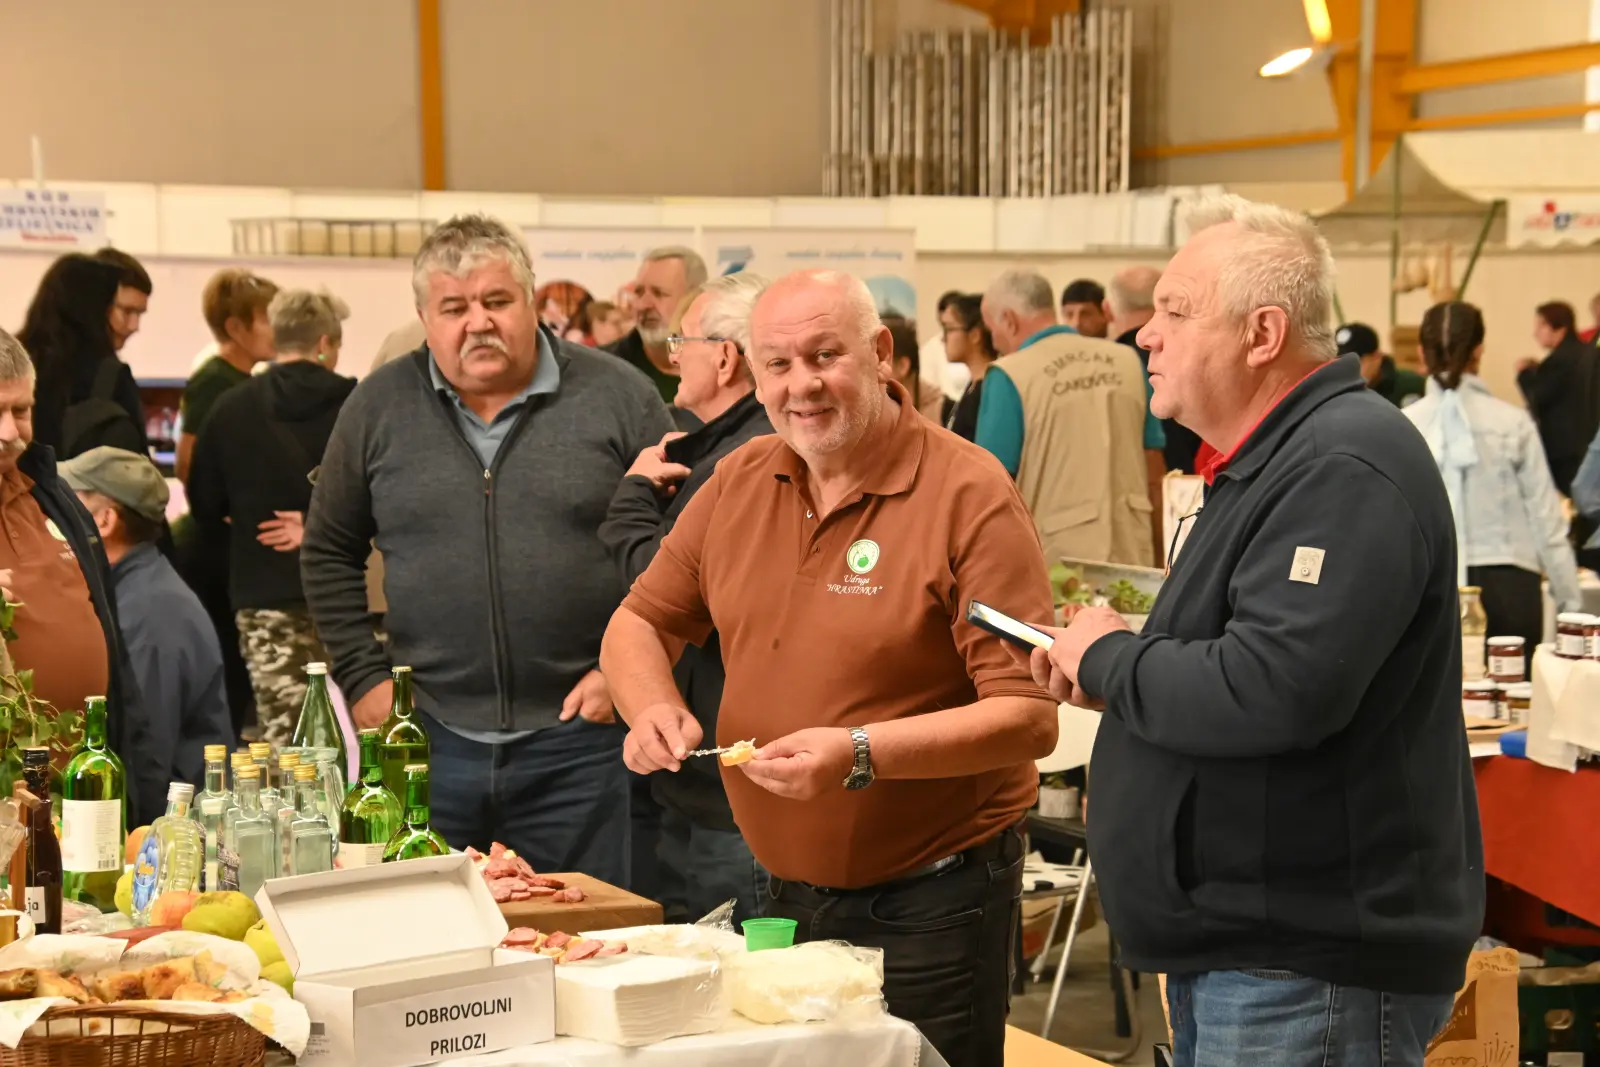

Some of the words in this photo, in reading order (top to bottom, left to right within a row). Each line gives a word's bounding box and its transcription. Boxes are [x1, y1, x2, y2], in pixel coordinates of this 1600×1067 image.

[843, 574, 870, 586] Udruga
[405, 997, 512, 1028] DOBROVOLJNI
[430, 1033, 486, 1056] PRILOZI
